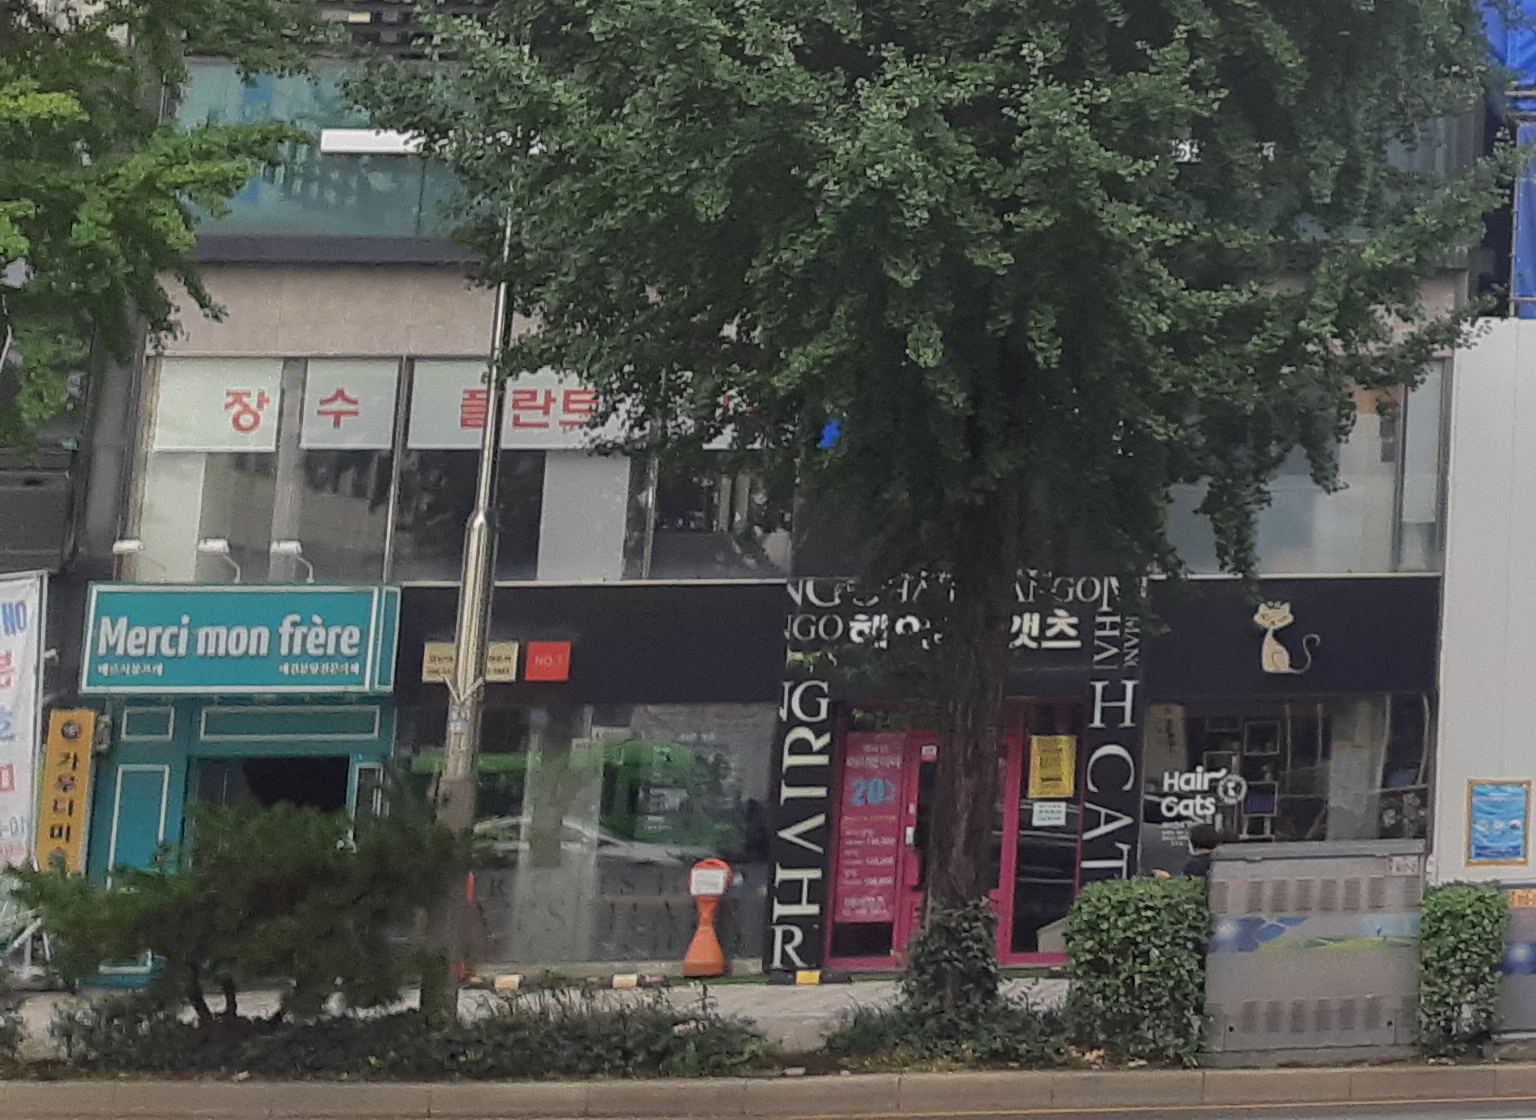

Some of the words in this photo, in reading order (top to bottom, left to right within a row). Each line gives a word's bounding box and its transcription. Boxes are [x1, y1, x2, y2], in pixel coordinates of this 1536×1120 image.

[97, 614, 191, 658] Merci
[196, 624, 270, 657] mon
[278, 613, 361, 657] frère
[1163, 765, 1228, 792] Hair
